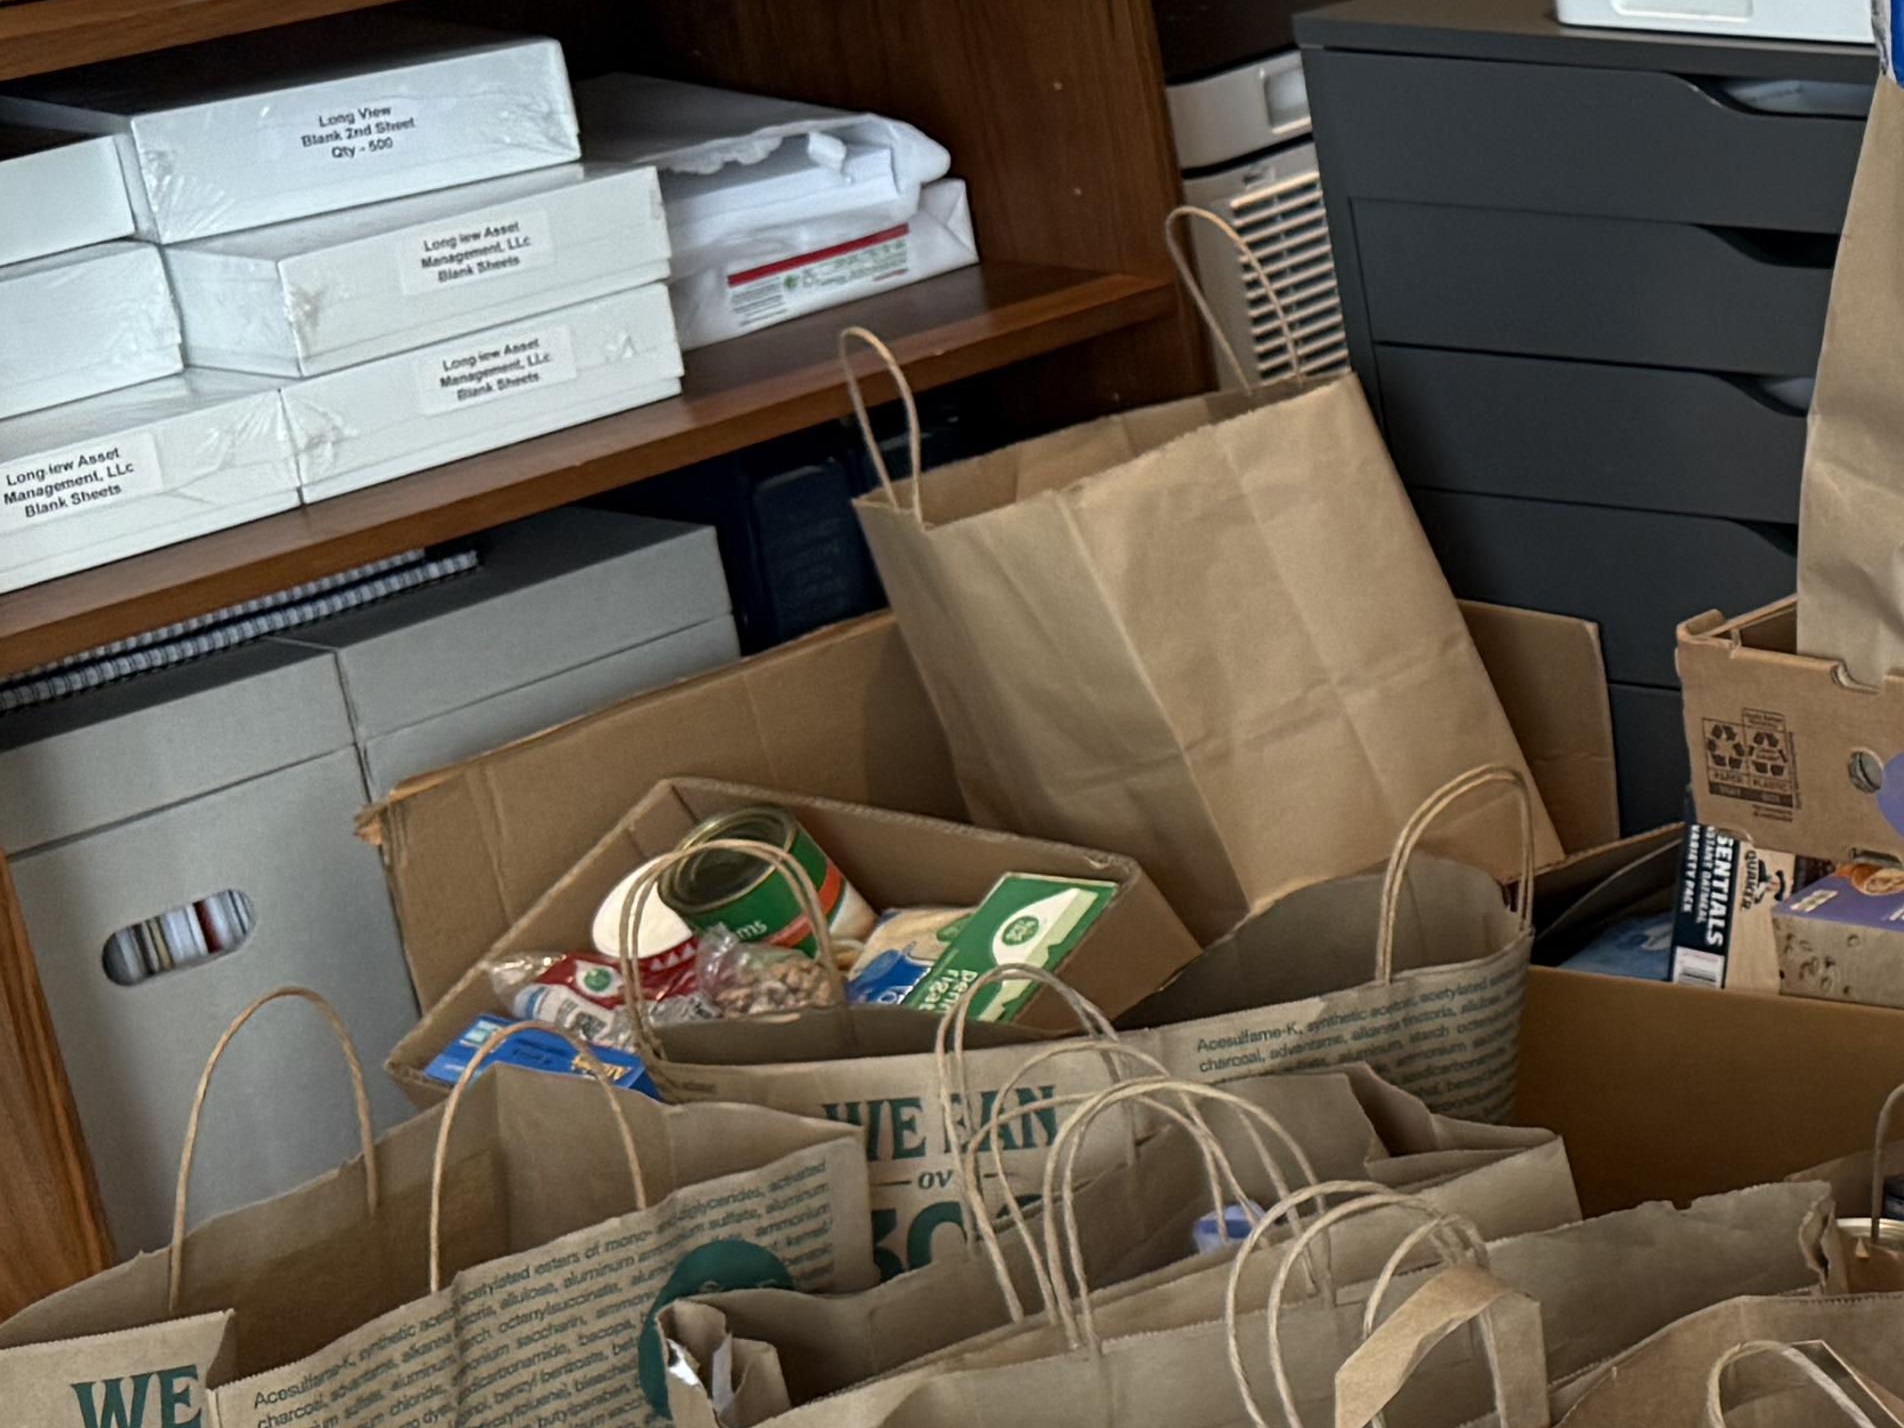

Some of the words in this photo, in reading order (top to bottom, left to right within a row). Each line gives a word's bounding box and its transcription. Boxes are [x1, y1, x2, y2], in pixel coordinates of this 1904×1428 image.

[319, 113, 355, 127] Long
[301, 130, 342, 147] Blank
[78, 447, 120, 468] Asset
[3, 470, 104, 504] Management,
[25, 496, 69, 518] Blank
[70, 484, 122, 505] Sheets
[1706, 834, 1734, 946] SENTIALS
[825, 1095, 927, 1166] WE
